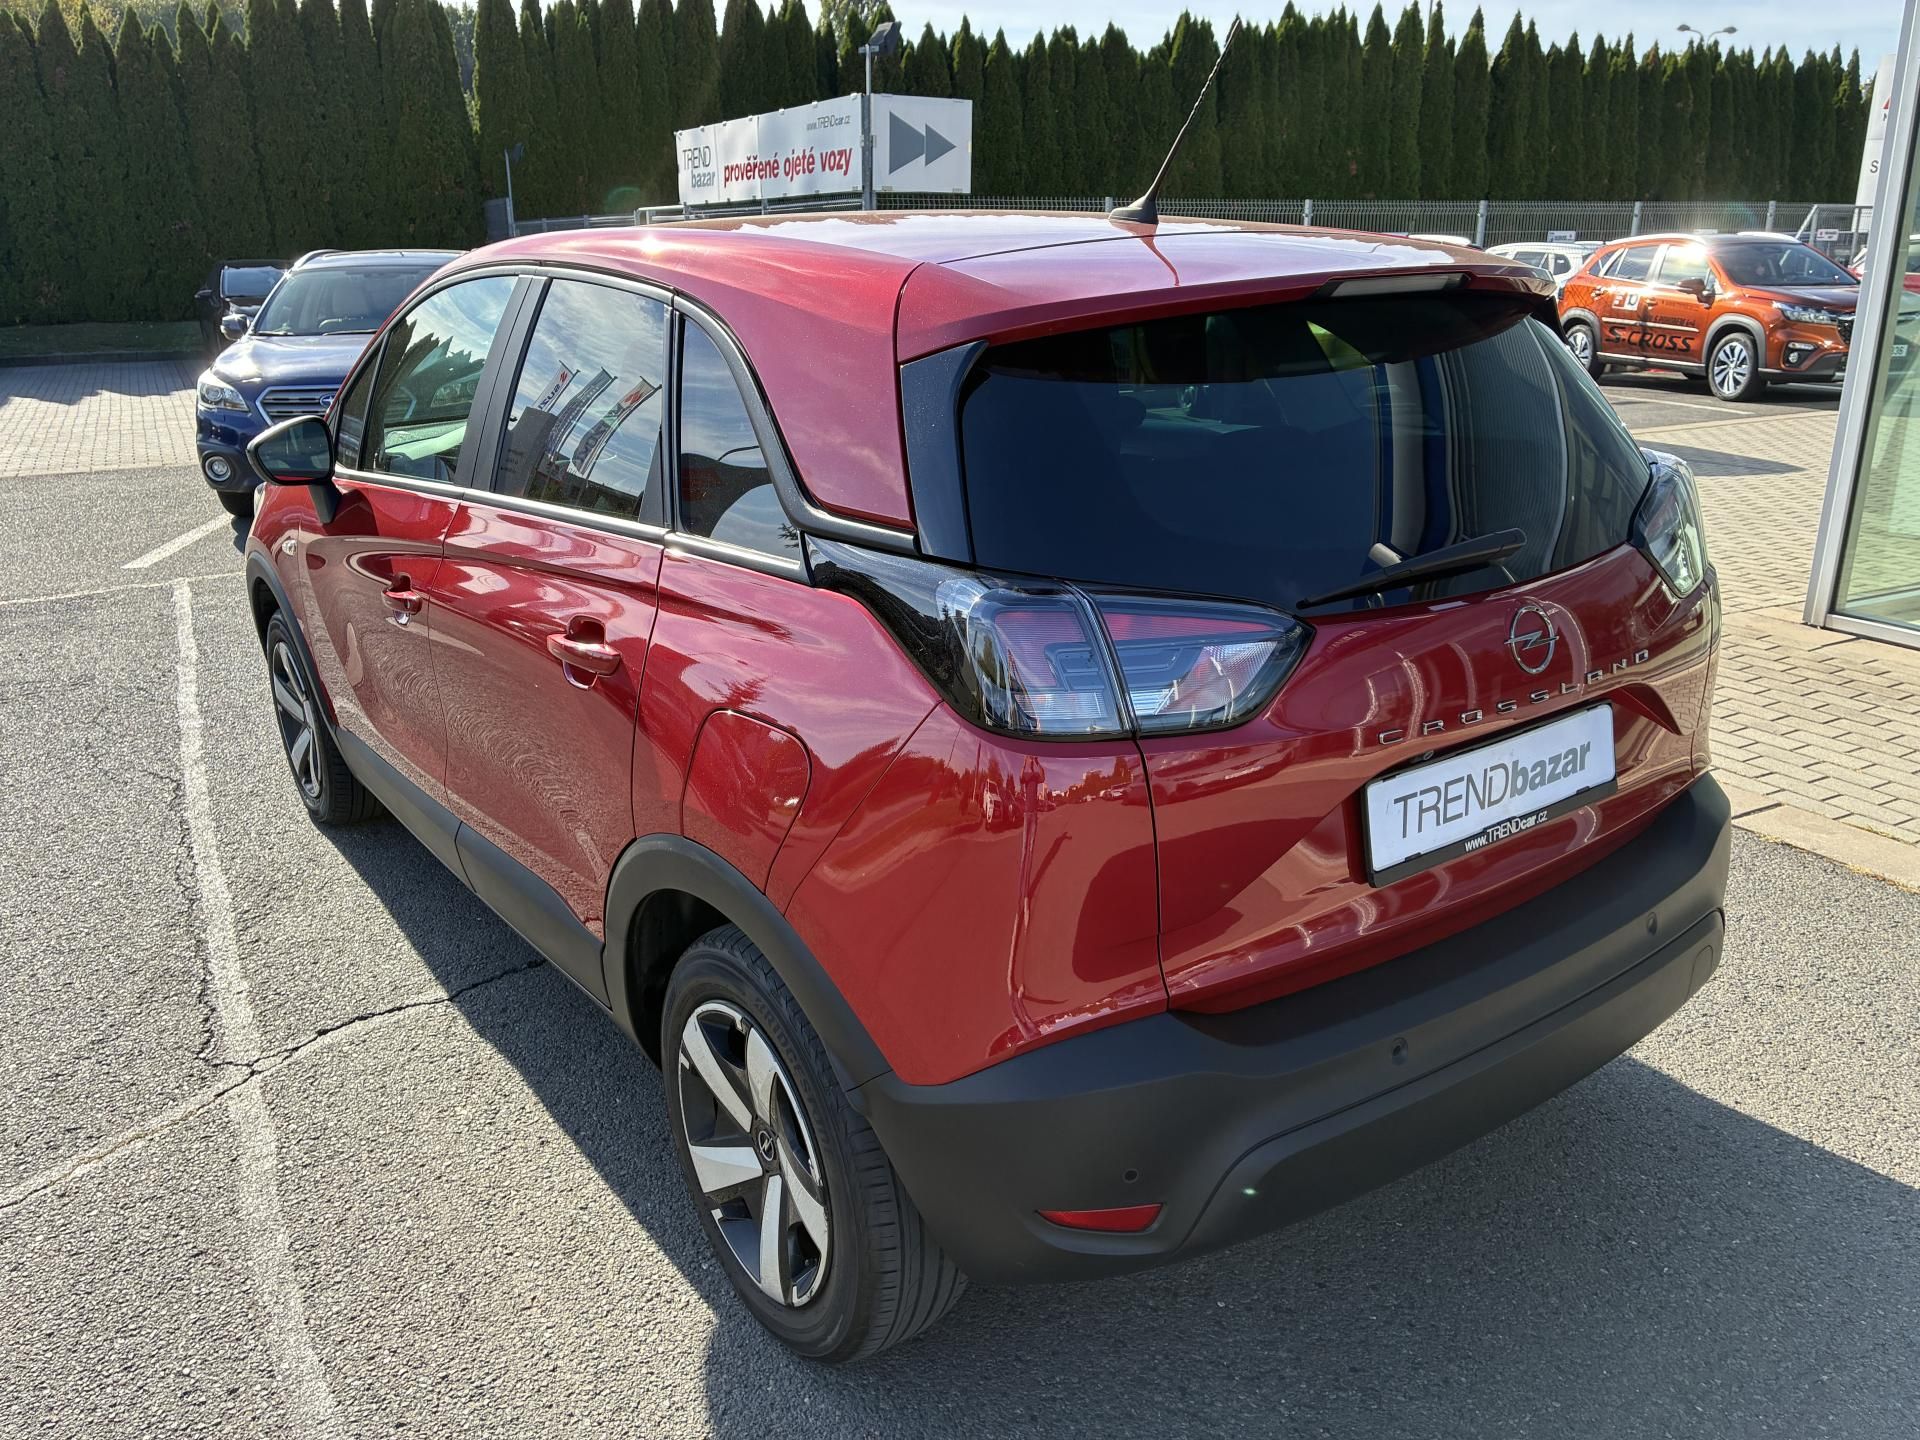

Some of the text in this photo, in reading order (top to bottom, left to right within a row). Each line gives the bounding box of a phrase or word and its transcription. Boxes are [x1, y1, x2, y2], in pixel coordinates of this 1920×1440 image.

[682, 145, 712, 171] TREND
[690, 168, 716, 188] bazar
[723, 146, 853, 188] prověřené ojeté vozy
[1378, 648, 1650, 745] CROSSLAND
[1393, 740, 1592, 839] TRENDbazar
[1464, 810, 1548, 852] www.TRENDcar.cz
